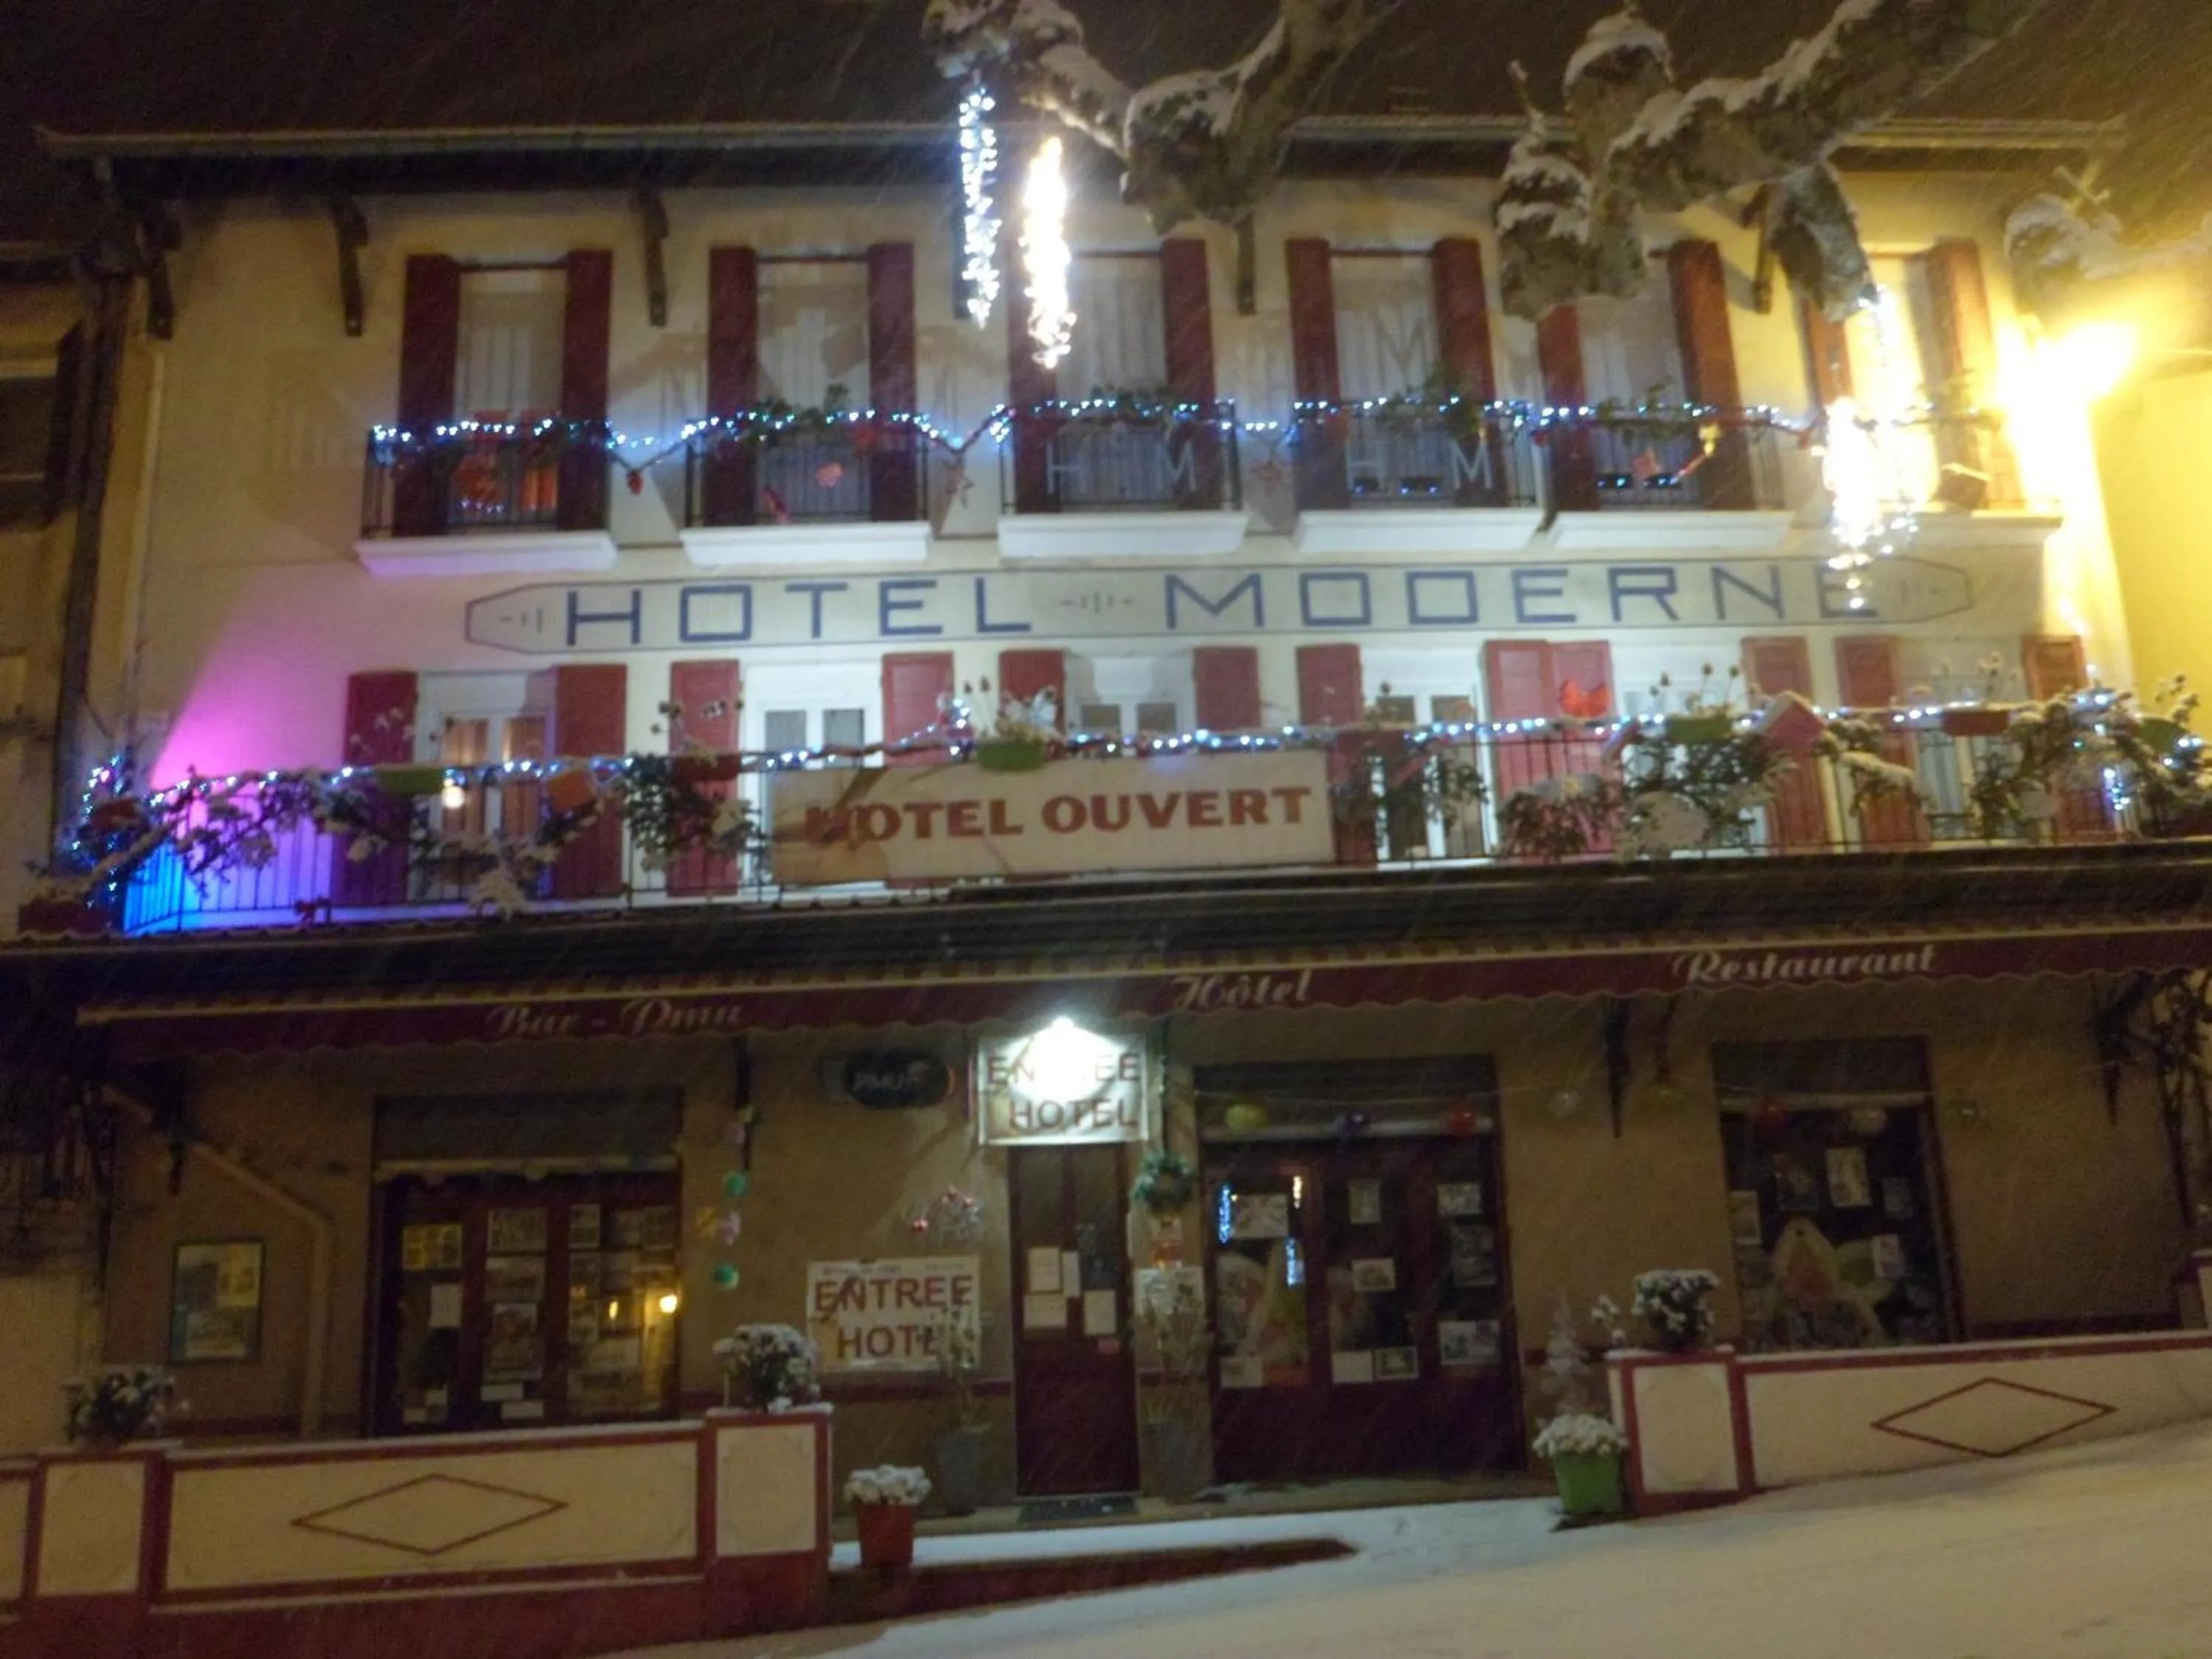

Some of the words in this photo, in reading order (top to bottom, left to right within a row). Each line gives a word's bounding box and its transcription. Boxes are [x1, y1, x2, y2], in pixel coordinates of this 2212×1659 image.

[566, 577, 1031, 646] HOTEL
[1165, 565, 1877, 629] MODERNE
[804, 799, 1023, 845] HOTEL
[1041, 787, 1312, 833] OUVERT
[1672, 943, 1938, 984] Restaurant
[1169, 970, 1312, 1009] Hôtel
[988, 1053, 1140, 1084] ENEE
[1011, 1100, 1138, 1130] HOTEL
[815, 1275, 973, 1311] ENTREE
